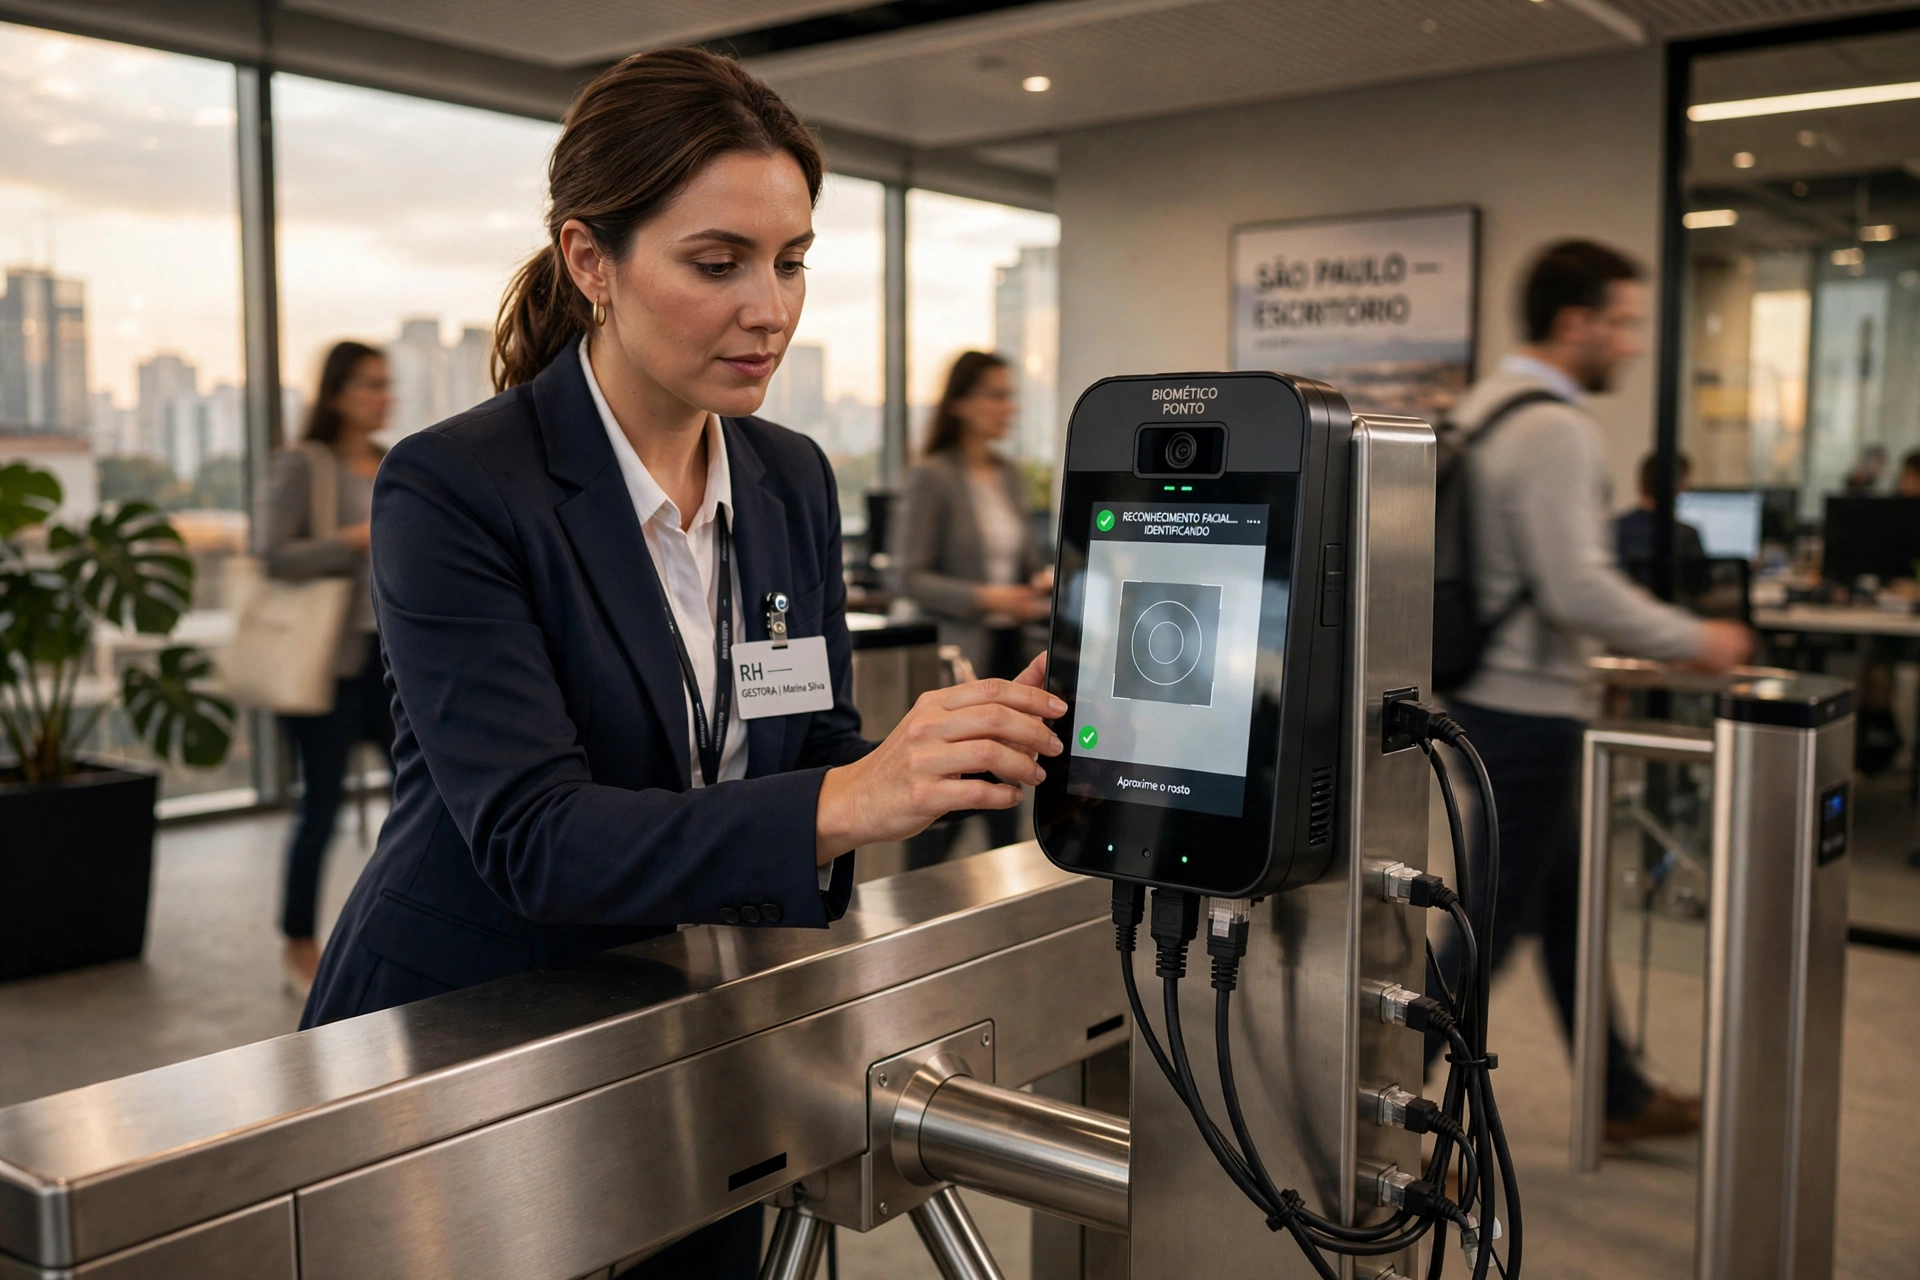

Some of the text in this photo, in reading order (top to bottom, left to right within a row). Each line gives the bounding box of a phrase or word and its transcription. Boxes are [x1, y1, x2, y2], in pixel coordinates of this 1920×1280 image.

[1315, 252, 1407, 288] PAULO
[1151, 385, 1218, 401] BIOMÉTICO
[1162, 402, 1205, 415] PONTO
[1122, 511, 1200, 523] RECONHECIMENTO
[740, 662, 763, 682] RH
[741, 686, 778, 698] GESTORA
[783, 683, 807, 694] Marina
[808, 681, 825, 692] Silva
[1160, 783, 1165, 791] o
[1168, 784, 1190, 795] rosto
